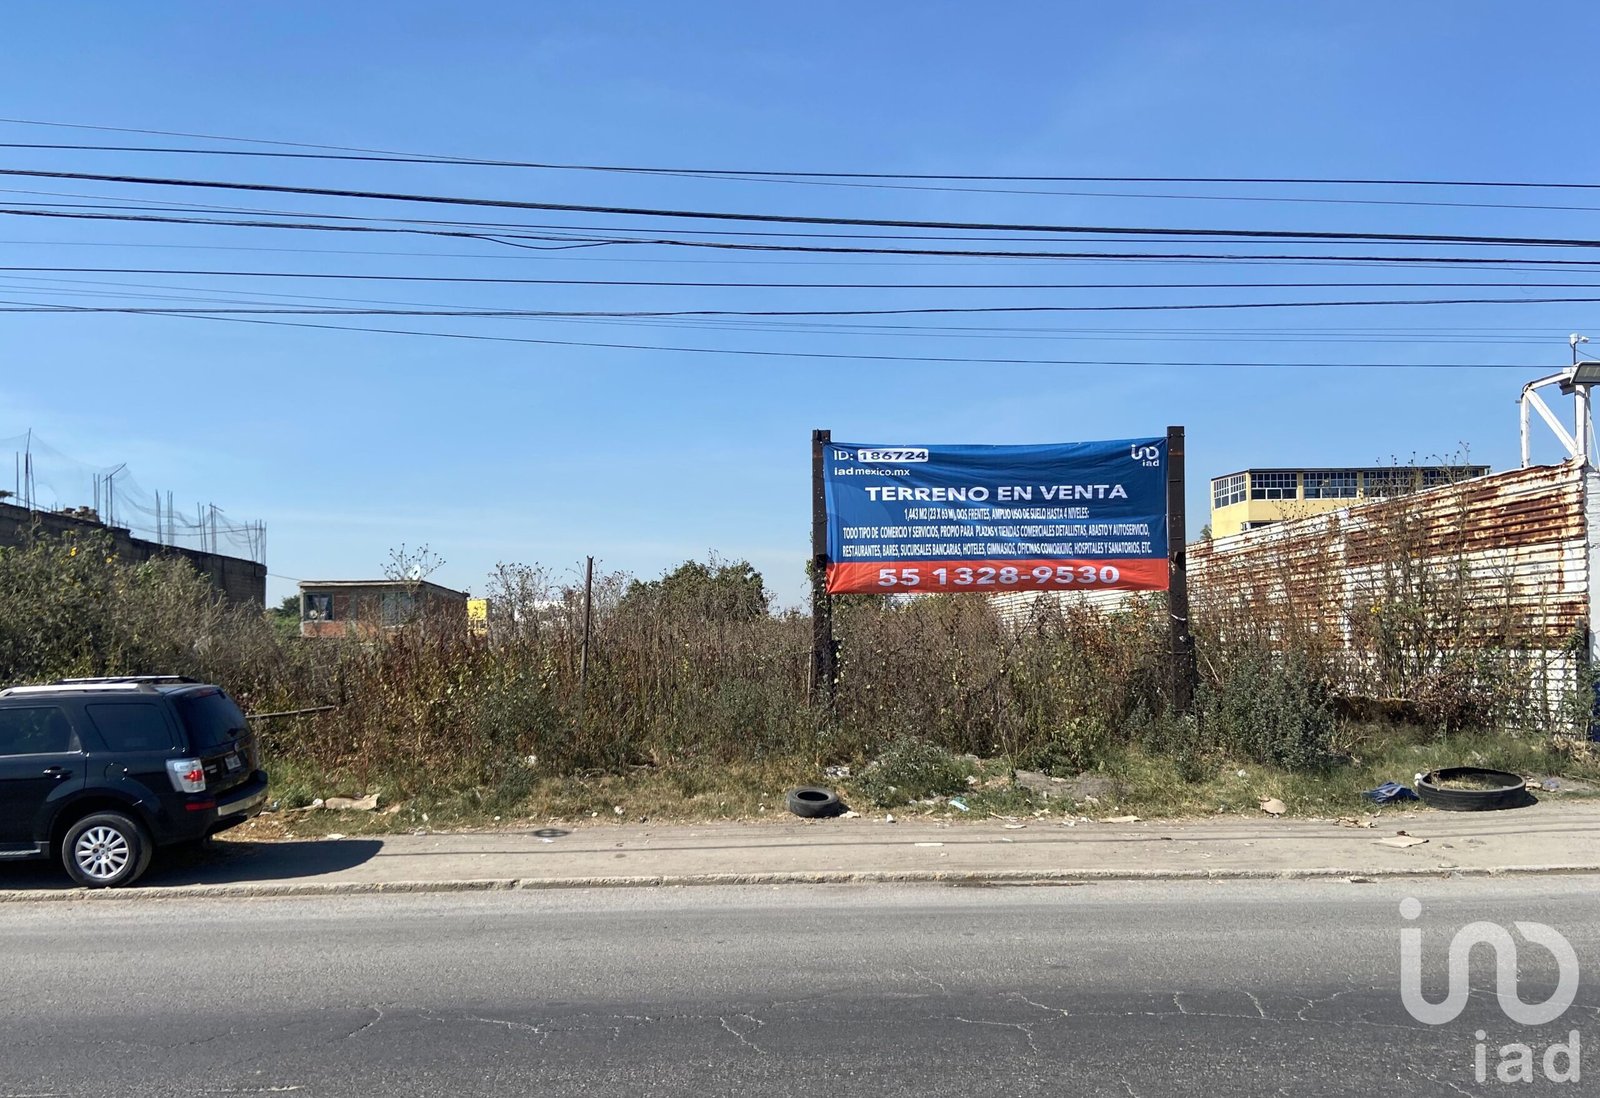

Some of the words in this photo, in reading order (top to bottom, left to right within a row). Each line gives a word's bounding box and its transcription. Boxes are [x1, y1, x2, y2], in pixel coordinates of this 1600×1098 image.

[833, 450, 854, 461] ID:
[860, 451, 927, 461] 186724
[865, 486, 989, 501] TERRENO
[998, 486, 1032, 501] EN
[1039, 484, 1128, 500] VENTA
[904, 507, 918, 521] 1,443
[919, 507, 927, 520] M2
[928, 507, 936, 521] (23
[957, 508, 968, 520] DOS
[968, 507, 991, 521] FRENTES,
[992, 507, 1011, 519] AMPLIO
[1011, 508, 1022, 519] USO
[1022, 508, 1030, 519] DE
[1030, 507, 1046, 519] SUELO
[1047, 507, 1063, 519] HASTA
[1068, 506, 1090, 519] NIVELES:
[843, 526, 858, 539] TODO
[859, 526, 871, 539] TIPO
[871, 526, 879, 539] DE
[880, 526, 908, 538] COMERCIO
[912, 525, 939, 539] SERVICIOS,
[940, 525, 959, 537] PROPIO
[960, 525, 974, 537] PARA
[976, 525, 994, 537] PLAZAS
[998, 525, 1020, 537] TIENDAS
[1020, 525, 1055, 537] COMERCIALES
[1055, 524, 1088, 538] DETALLISTAS,
[1088, 524, 1108, 537] ABASTO
[1113, 524, 1150, 537] AUTOSERVICIO,
[842, 544, 882, 558] RESTAURANTES,
[883, 544, 899, 558] BARES,
[900, 544, 931, 556] SUCURSALES
[932, 543, 962, 557] BANCARIAS,
[963, 543, 986, 556] HOTELES,
[986, 543, 1016, 556] GIMNASIOS,
[1017, 542, 1040, 555] OFICINAS
[1041, 542, 1073, 556] COWORKING,
[1074, 542, 1104, 554] HOSPITALES
[1108, 541, 1141, 555] SANATORIOS,
[1141, 541, 1152, 554] ETC.
[877, 568, 920, 587] 55
[932, 565, 1120, 585] 1328-9530
